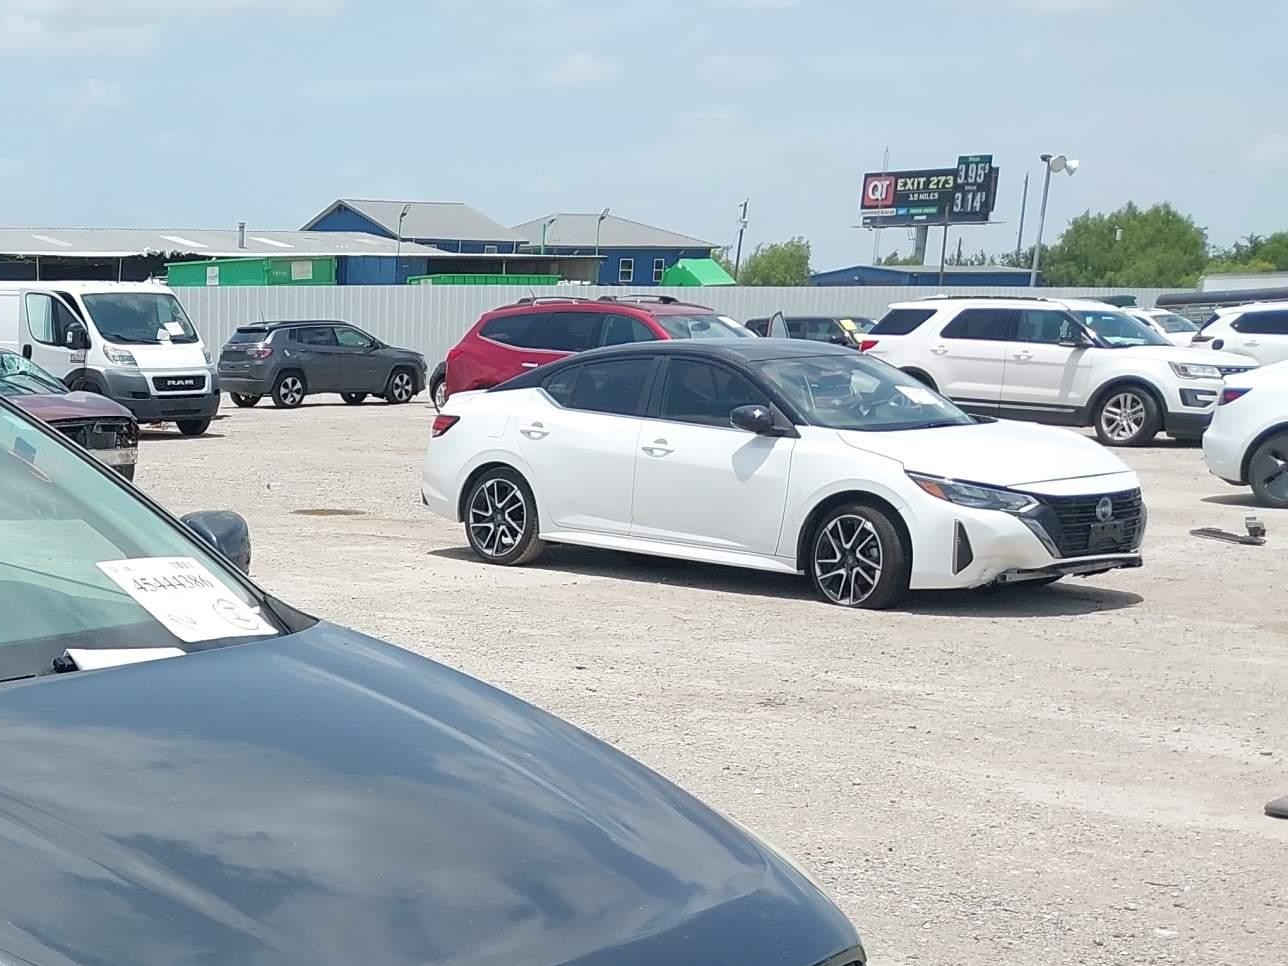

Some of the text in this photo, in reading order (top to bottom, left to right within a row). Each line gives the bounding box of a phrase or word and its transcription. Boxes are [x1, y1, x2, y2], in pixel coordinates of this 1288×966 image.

[868, 181, 891, 200] QT
[897, 176, 954, 191] EXIT 273
[919, 192, 939, 200] MILES
[132, 574, 214, 593] 45444386
